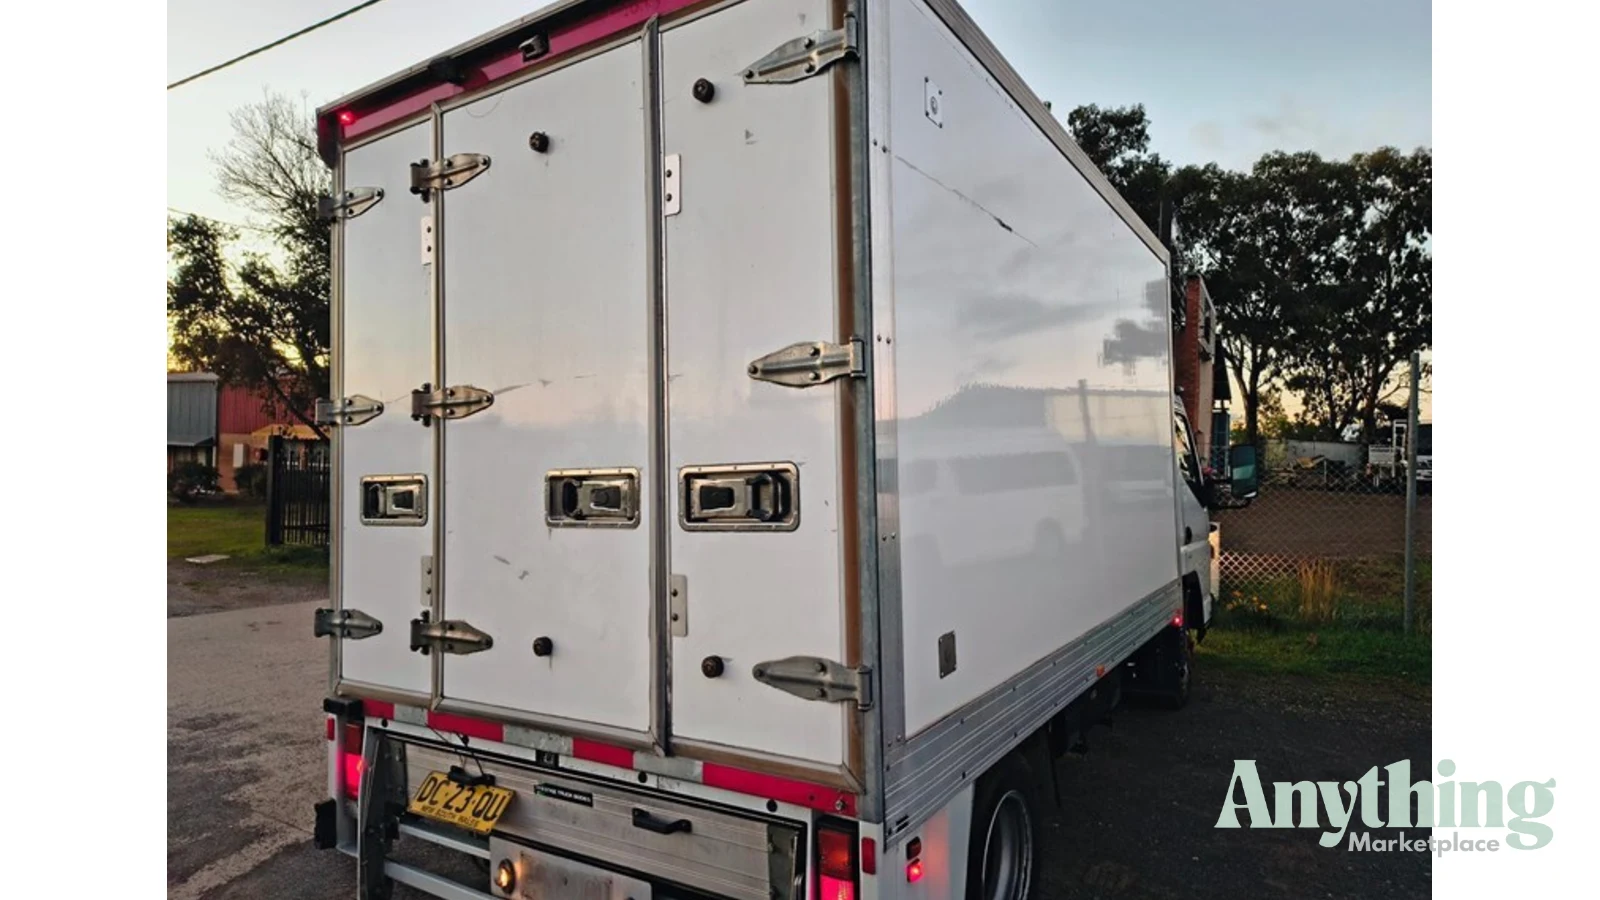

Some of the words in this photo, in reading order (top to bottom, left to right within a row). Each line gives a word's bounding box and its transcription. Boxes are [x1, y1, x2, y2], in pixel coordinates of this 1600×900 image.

[421, 804, 435, 814] NEW
[435, 808, 457, 820] SOUTH
[457, 814, 480, 828] WALES
